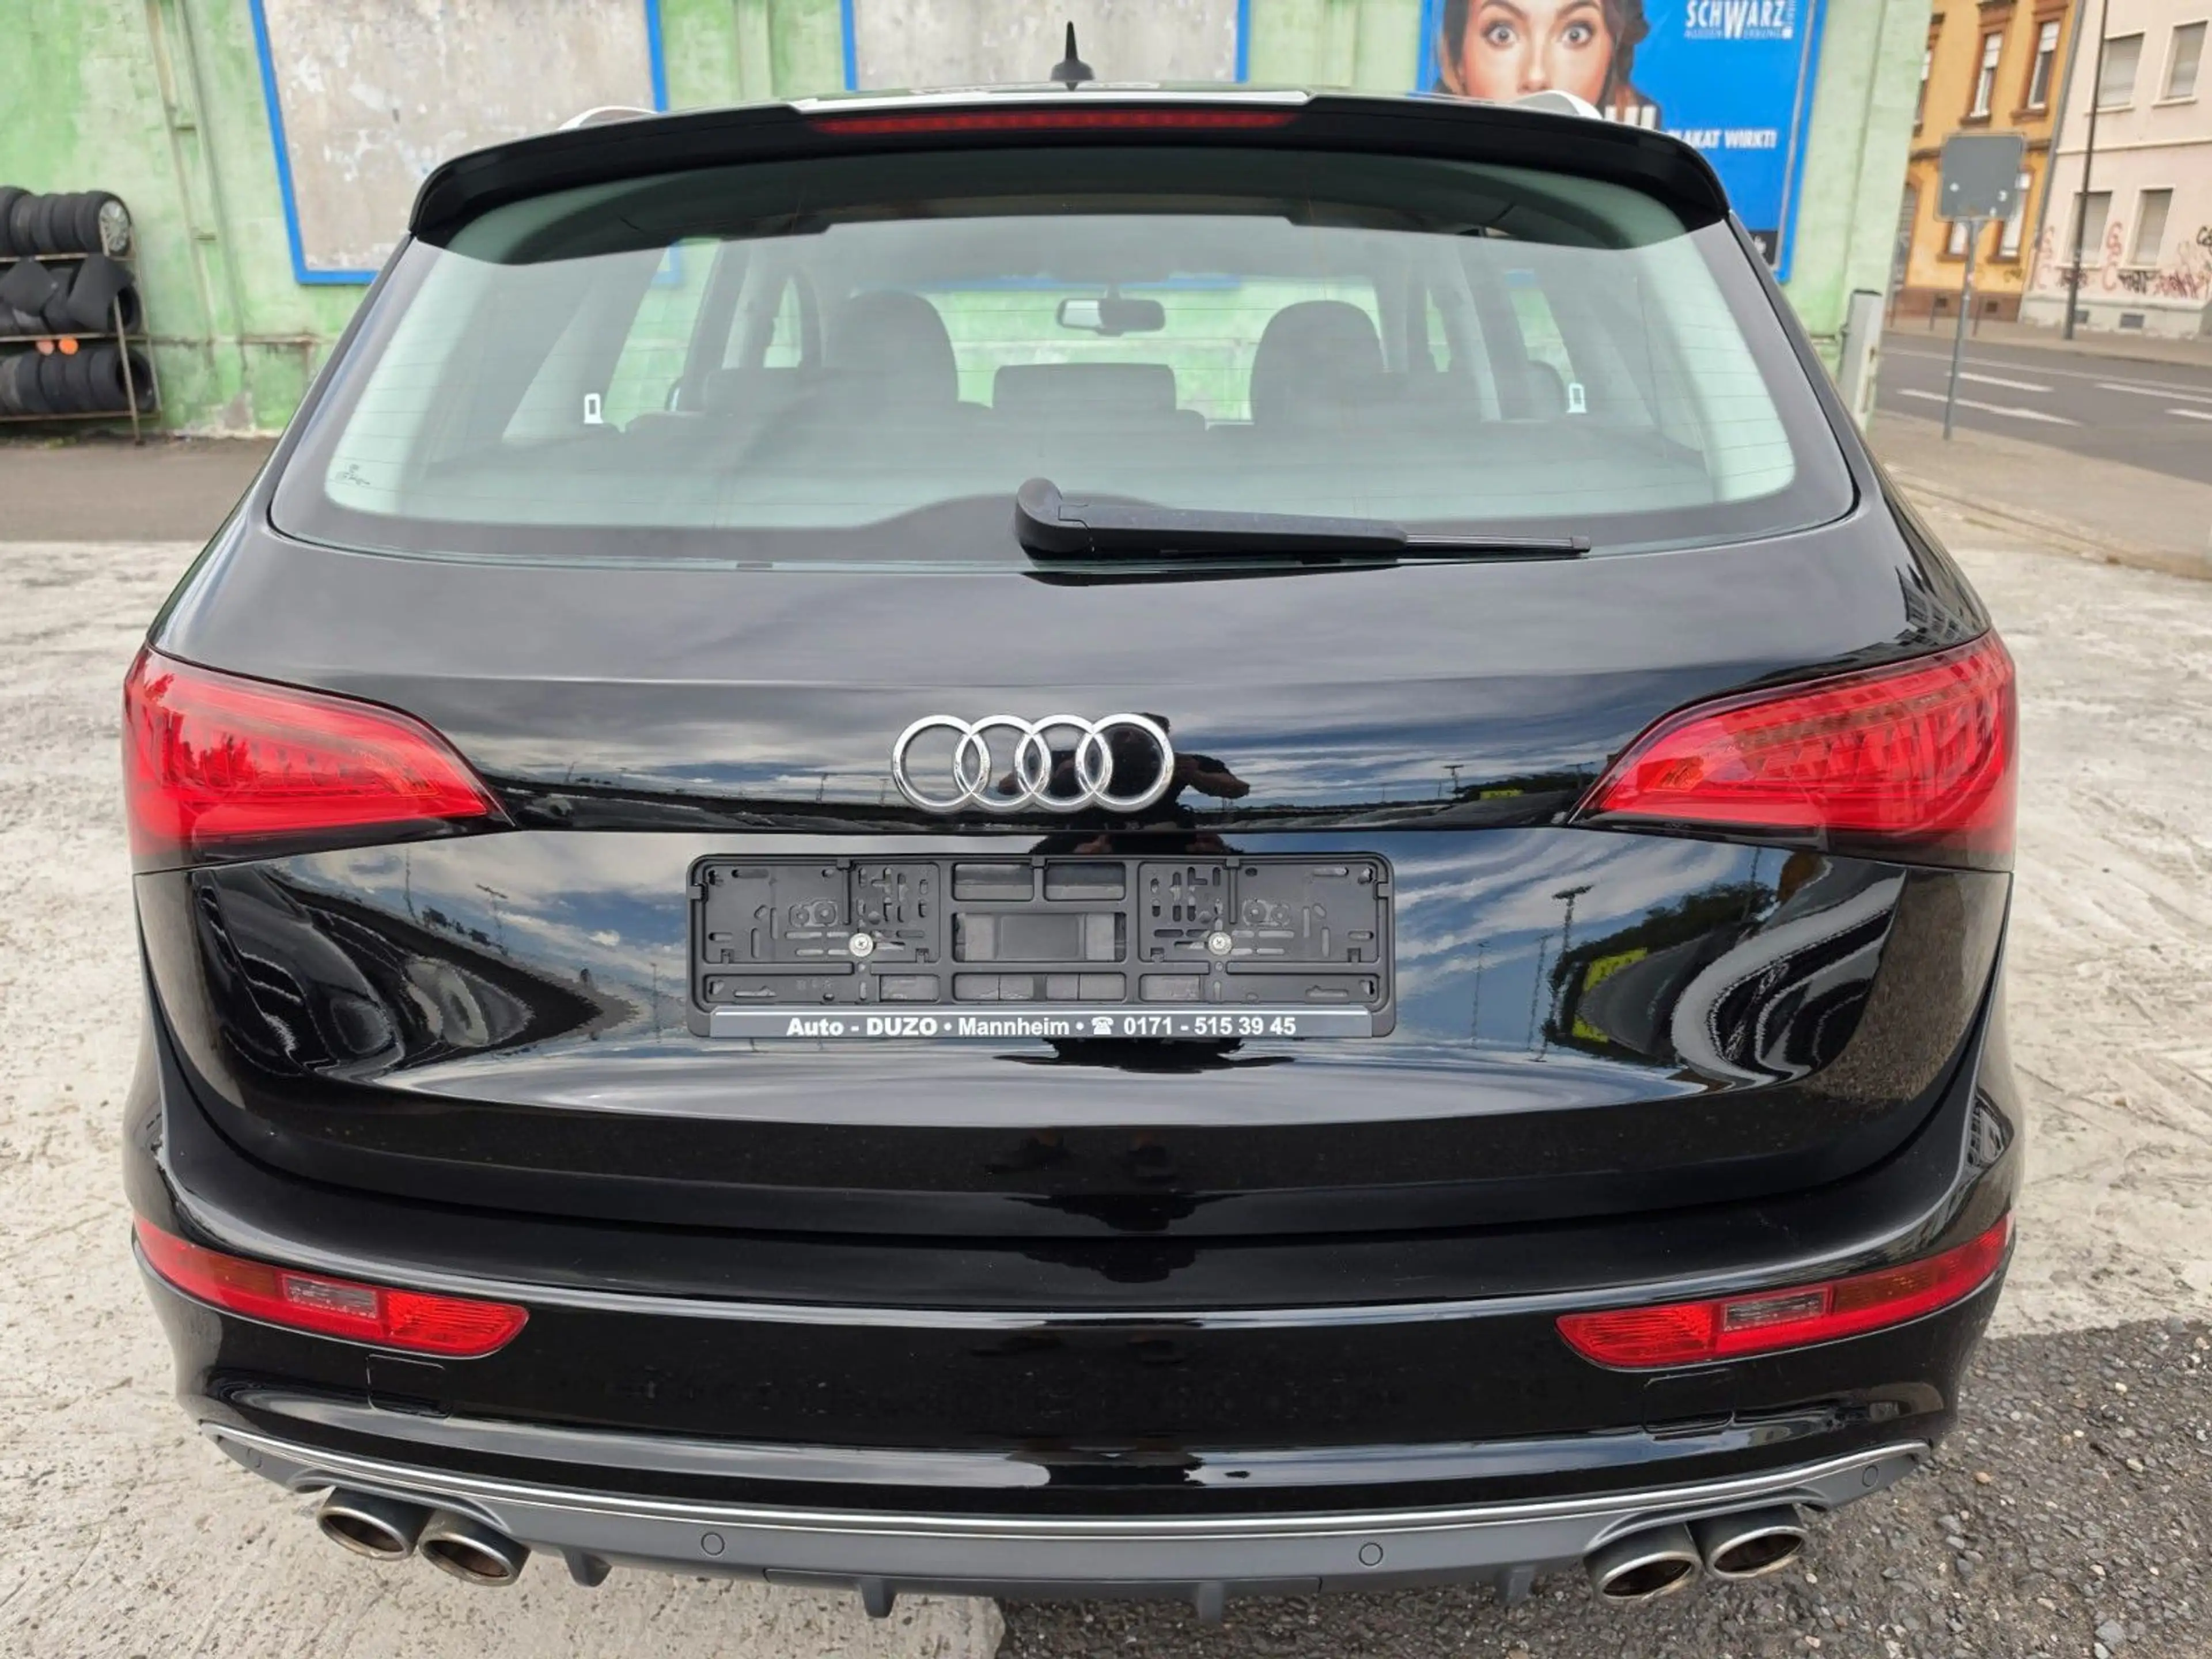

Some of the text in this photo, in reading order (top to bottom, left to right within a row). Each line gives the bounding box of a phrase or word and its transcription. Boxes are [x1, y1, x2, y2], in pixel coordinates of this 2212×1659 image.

[1685, 0, 1785, 39] SCHWARZ
[786, 1017, 844, 1035] Auto
[866, 1017, 938, 1035] DUZO
[959, 1017, 1070, 1035] Mannheim
[1124, 1017, 1172, 1035] 0171
[1195, 1017, 1233, 1035] 515
[1238, 1017, 1264, 1035] 39
[1270, 1017, 1296, 1035] 45
